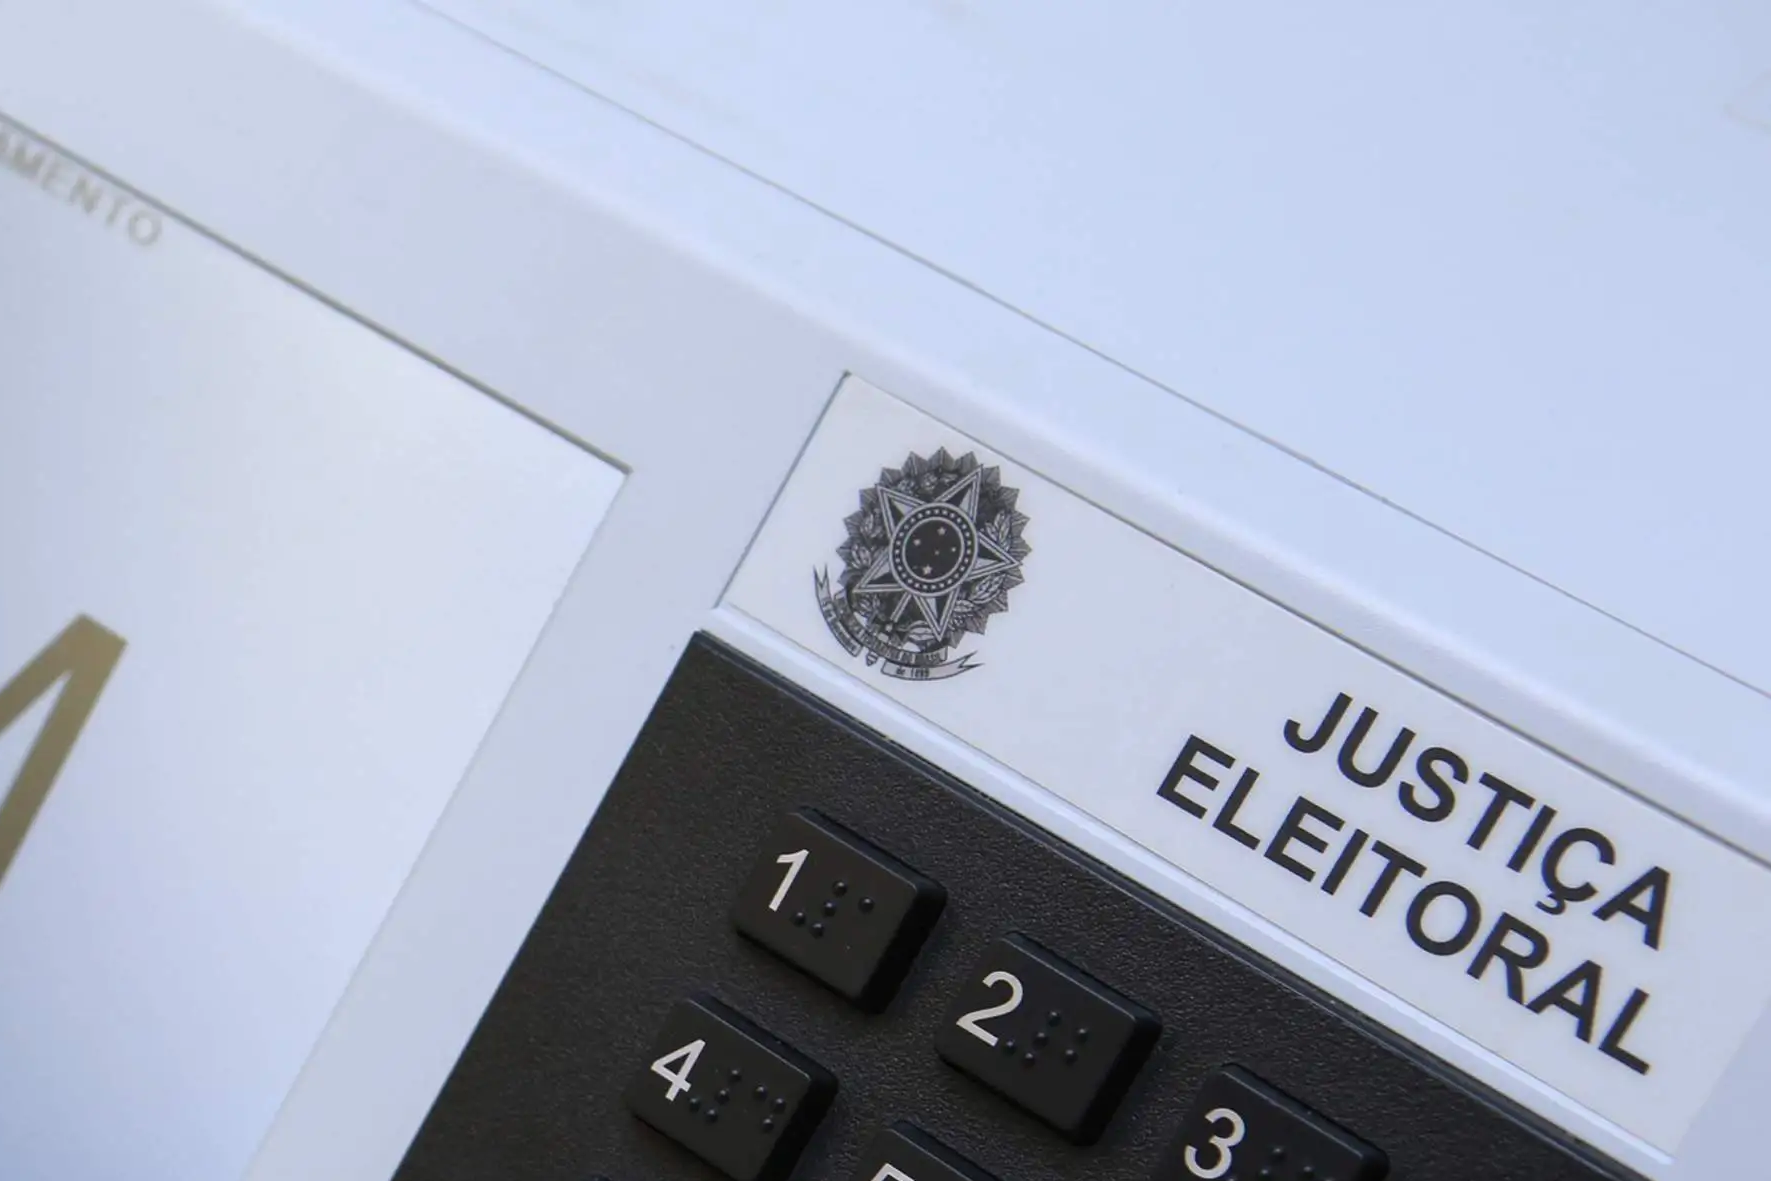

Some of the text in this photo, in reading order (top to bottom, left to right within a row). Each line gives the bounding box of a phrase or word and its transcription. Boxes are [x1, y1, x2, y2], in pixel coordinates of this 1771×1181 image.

[1282, 691, 1671, 951] JUSTIÇA
[768, 848, 810, 913] 1
[1155, 733, 1651, 1077] ELEITORAL
[955, 970, 1024, 1047] 2
[650, 1038, 707, 1102] 4
[1183, 1107, 1246, 1180] 3
